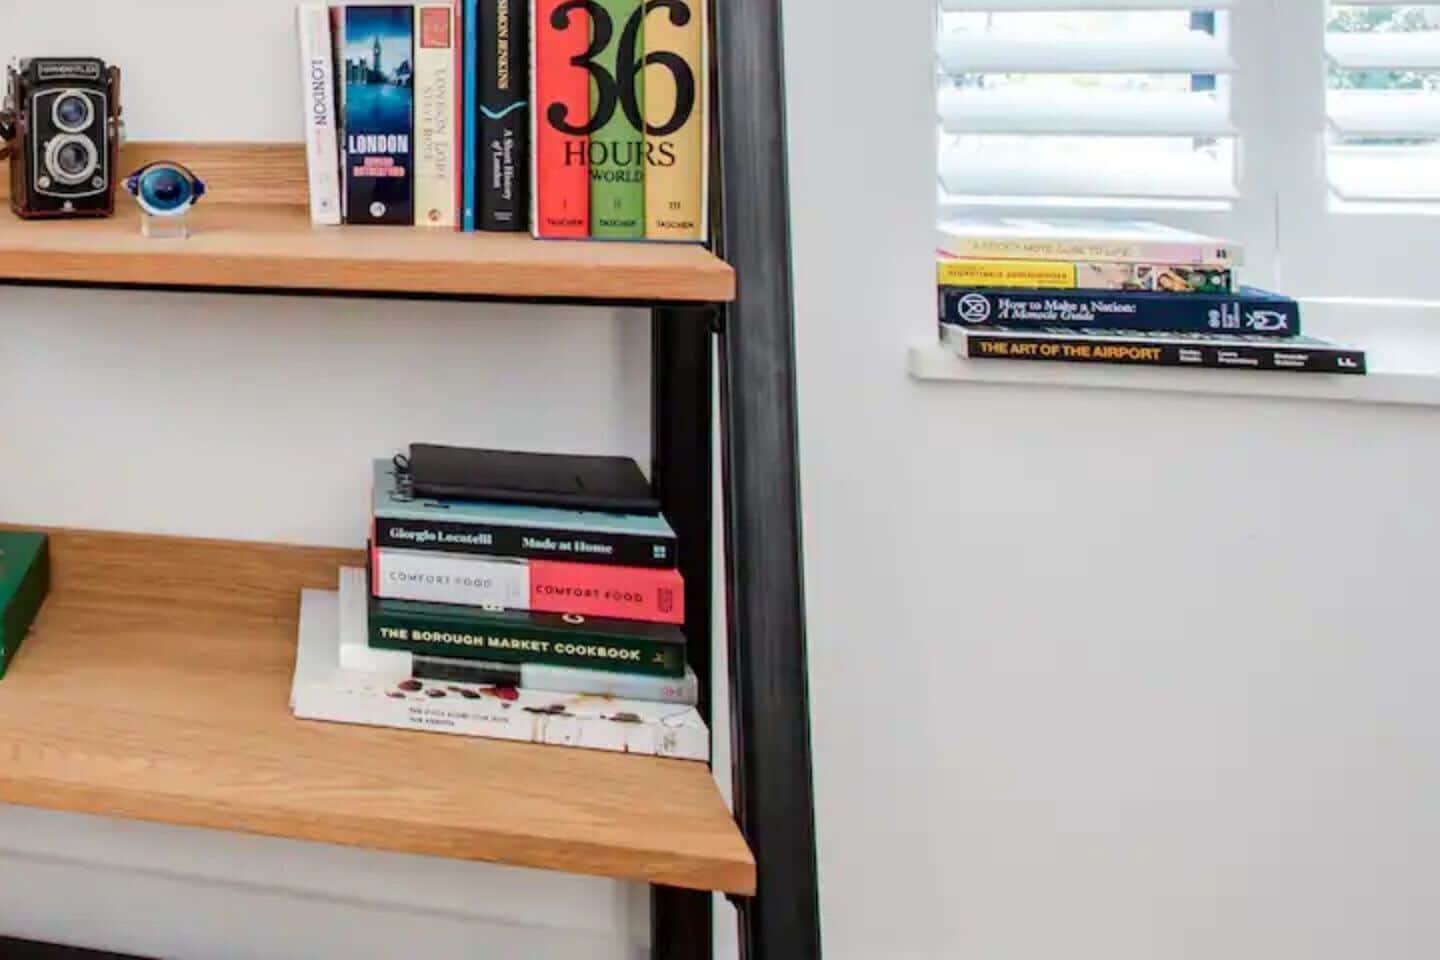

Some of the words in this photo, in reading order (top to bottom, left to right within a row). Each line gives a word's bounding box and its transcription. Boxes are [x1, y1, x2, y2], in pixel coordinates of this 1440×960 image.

[497, 38, 508, 90] JENKINS
[311, 60, 327, 125] LONDON
[349, 134, 409, 153] LONDON
[564, 140, 676, 167] HOURS
[591, 170, 642, 183] WORLD
[998, 299, 1026, 312] How
[1030, 301, 1041, 311] to
[1045, 300, 1077, 313] Make
[1080, 304, 1088, 314] a
[981, 342, 1009, 355] THE
[1011, 343, 1037, 355] ART
[1039, 344, 1060, 356] OF
[1064, 344, 1093, 357] THE
[1094, 345, 1162, 360] AIRPORT
[389, 527, 436, 542] Giorgio
[438, 530, 493, 545] Locatelli
[522, 537, 557, 551] Made
[559, 540, 572, 552] at
[574, 541, 613, 555] Home
[389, 571, 451, 585] COMFORT
[536, 584, 599, 598] COMFORT
[604, 592, 643, 603] FOOD
[380, 627, 407, 640] THE
[412, 630, 483, 647] BOROUGH
[488, 636, 548, 653] MARKET
[554, 643, 641, 661] COOKBOOK
